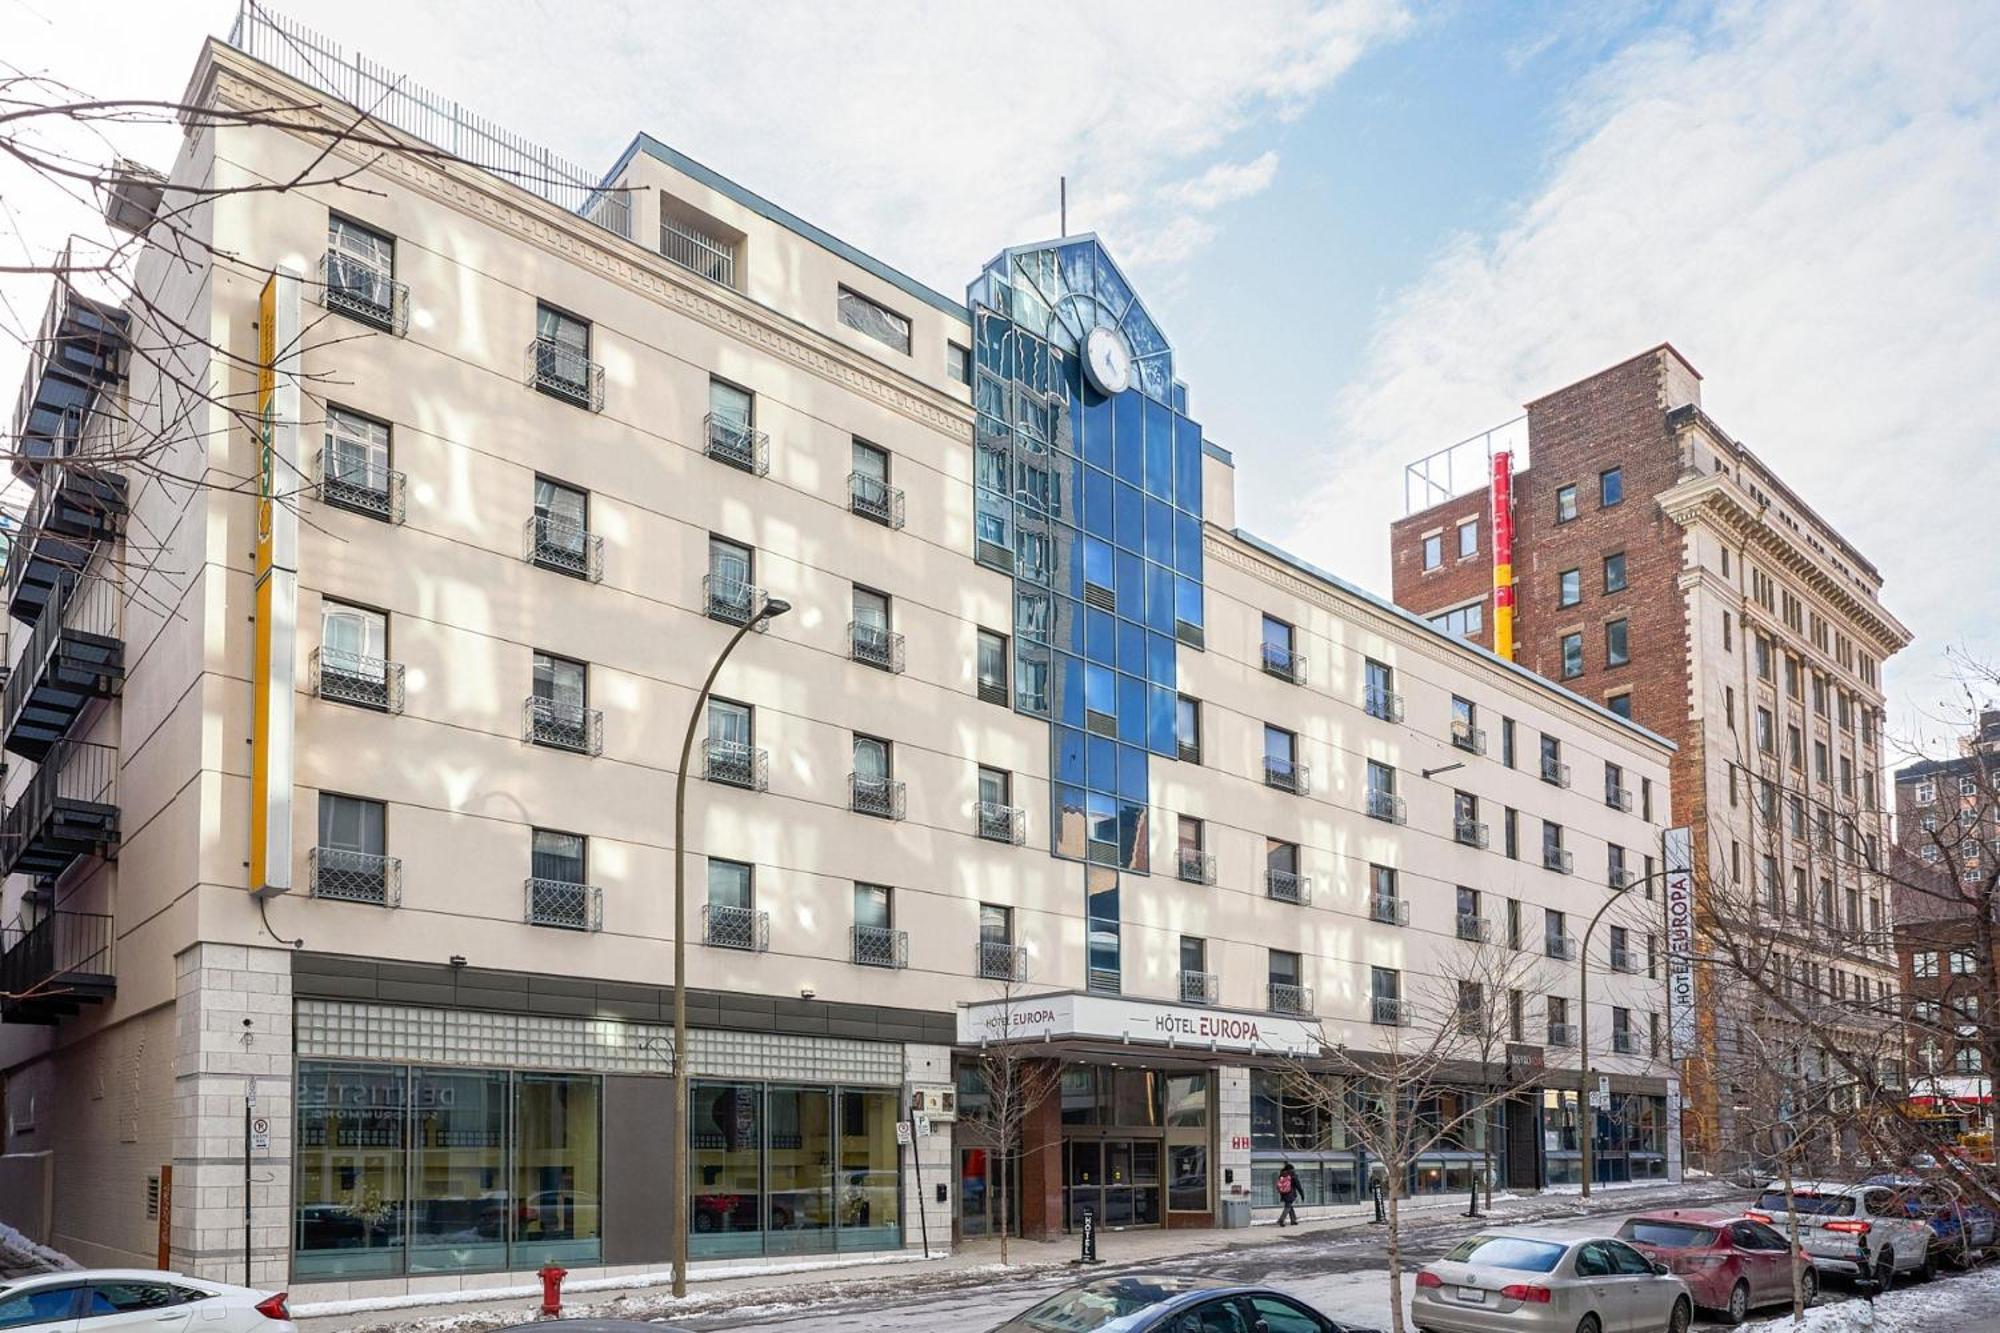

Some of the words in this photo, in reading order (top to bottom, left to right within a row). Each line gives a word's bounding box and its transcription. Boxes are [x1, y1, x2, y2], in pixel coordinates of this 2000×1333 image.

[1671, 878, 1689, 951] EUROPA
[1013, 1010, 1055, 1025] EUROPA
[1155, 1013, 1196, 1034] HÔTEL
[1200, 1017, 1259, 1041] EUROPA
[1084, 1216, 1092, 1254] HOTEL
